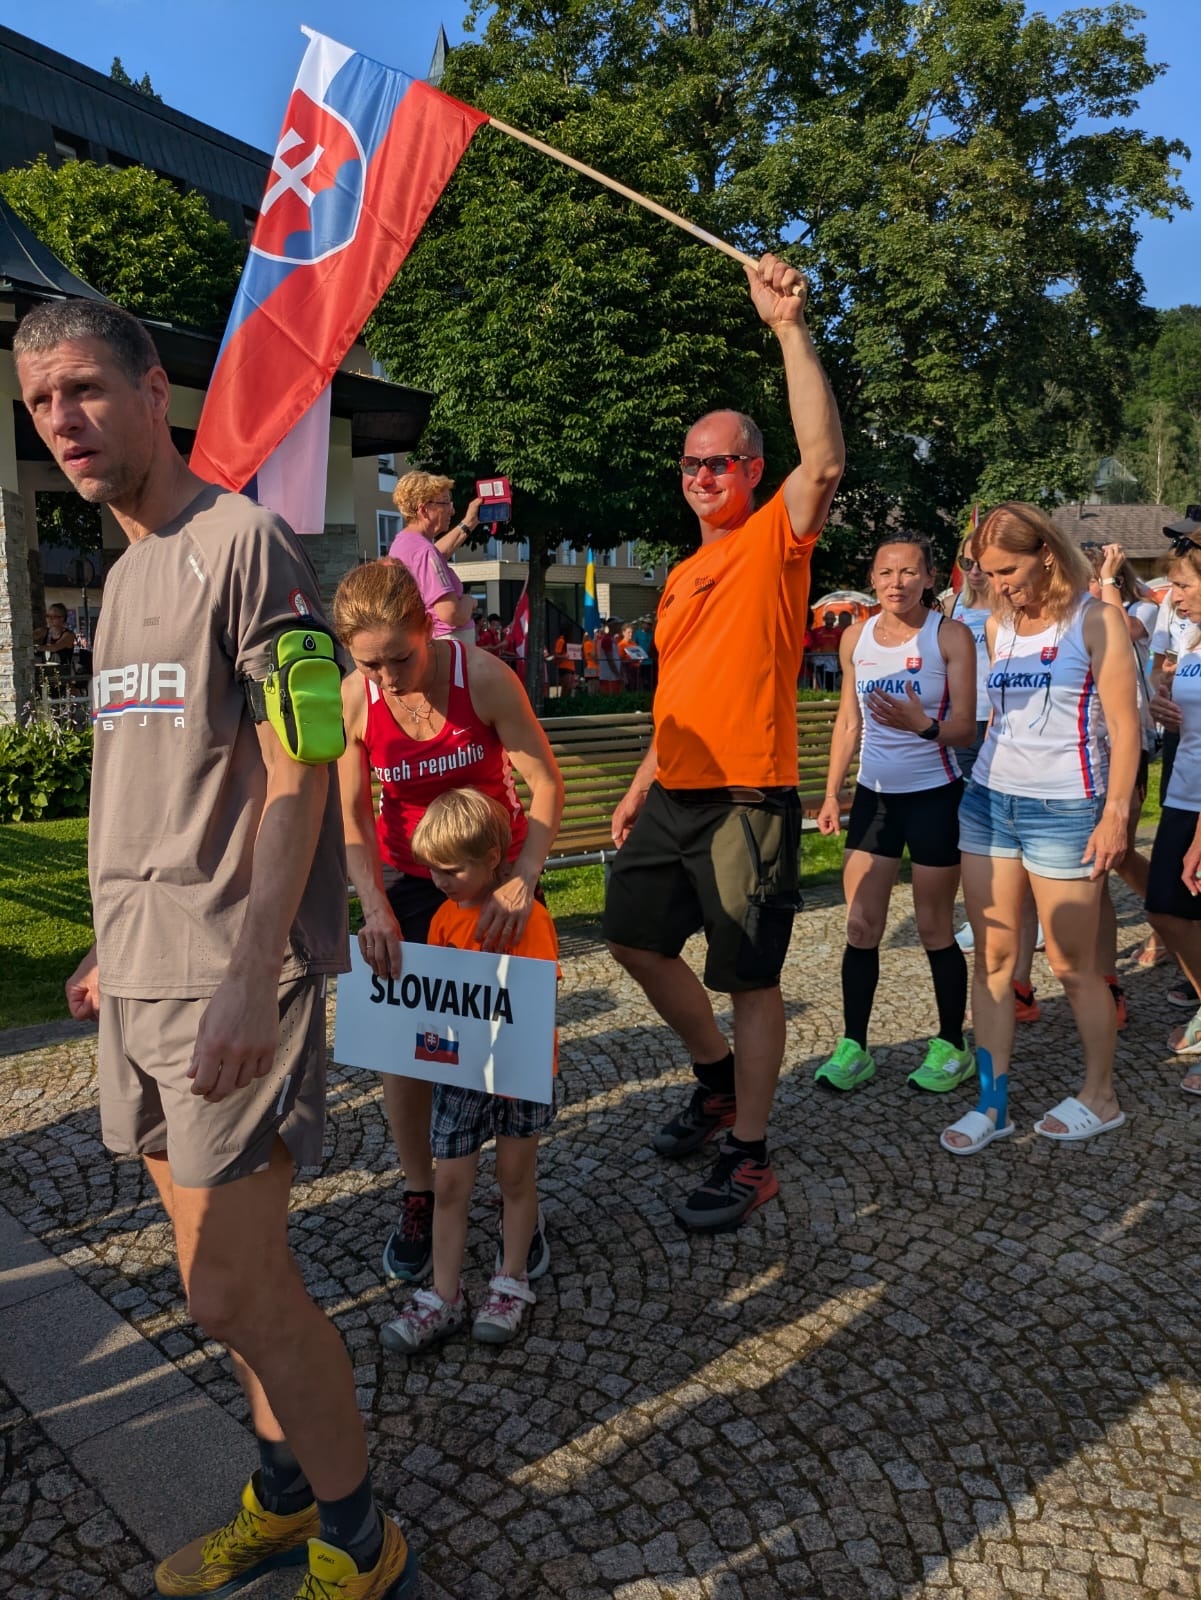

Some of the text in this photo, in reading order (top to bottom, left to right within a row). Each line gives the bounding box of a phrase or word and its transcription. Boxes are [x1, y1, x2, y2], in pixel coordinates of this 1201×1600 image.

[857, 679, 922, 695] SLOVAKA
[987, 672, 1051, 688] LOVAKIA
[419, 743, 485, 776] republic
[370, 974, 514, 1025] SLOVAKIA
